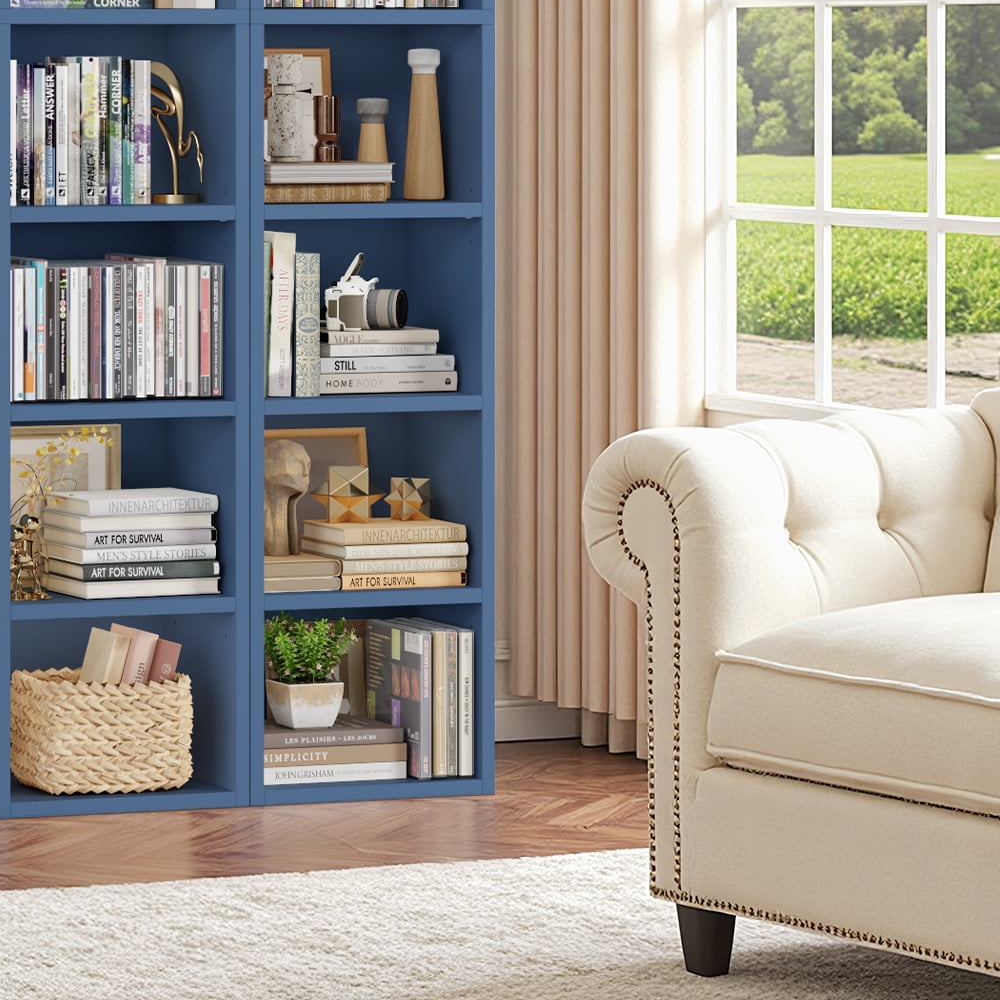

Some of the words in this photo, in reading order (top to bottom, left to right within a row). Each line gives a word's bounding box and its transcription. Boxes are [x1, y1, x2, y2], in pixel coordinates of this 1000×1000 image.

[45, 74, 55, 120] ANSWER
[98, 75, 108, 119] Hammer
[111, 69, 120, 114] CORNER
[87, 153, 95, 187] FANCY
[278, 268, 289, 302] AFTER
[277, 305, 288, 331] DAYS
[334, 360, 356, 371] STILL
[326, 379, 353, 388] HOME
[356, 379, 384, 388] BODY
[108, 497, 211, 513] INNENARCHITEKTUR
[94, 536, 108, 544] ART
[111, 535, 127, 544] FOR
[129, 533, 164, 543] SURVIVAL
[362, 527, 460, 543] INNENARCHITEKTUR
[97, 551, 128, 561] MEN'S
[130, 550, 162, 561] STYLE
[165, 548, 206, 560] STORIES
[91, 567, 106, 578] ART
[109, 567, 126, 577] FOR
[128, 566, 164, 576] SURVIVAL
[354, 562, 384, 571] MEN'S
[386, 561, 417, 571] STYLE
[420, 560, 458, 569] STORIES
[350, 578, 363, 587] ART
[366, 577, 381, 586] FOR
[383, 576, 416, 585] SURVIVAL
[264, 752, 328, 763] SIMPLICITY
[274, 770, 298, 781] JOHN
[298, 769, 334, 779] GRISHAM
